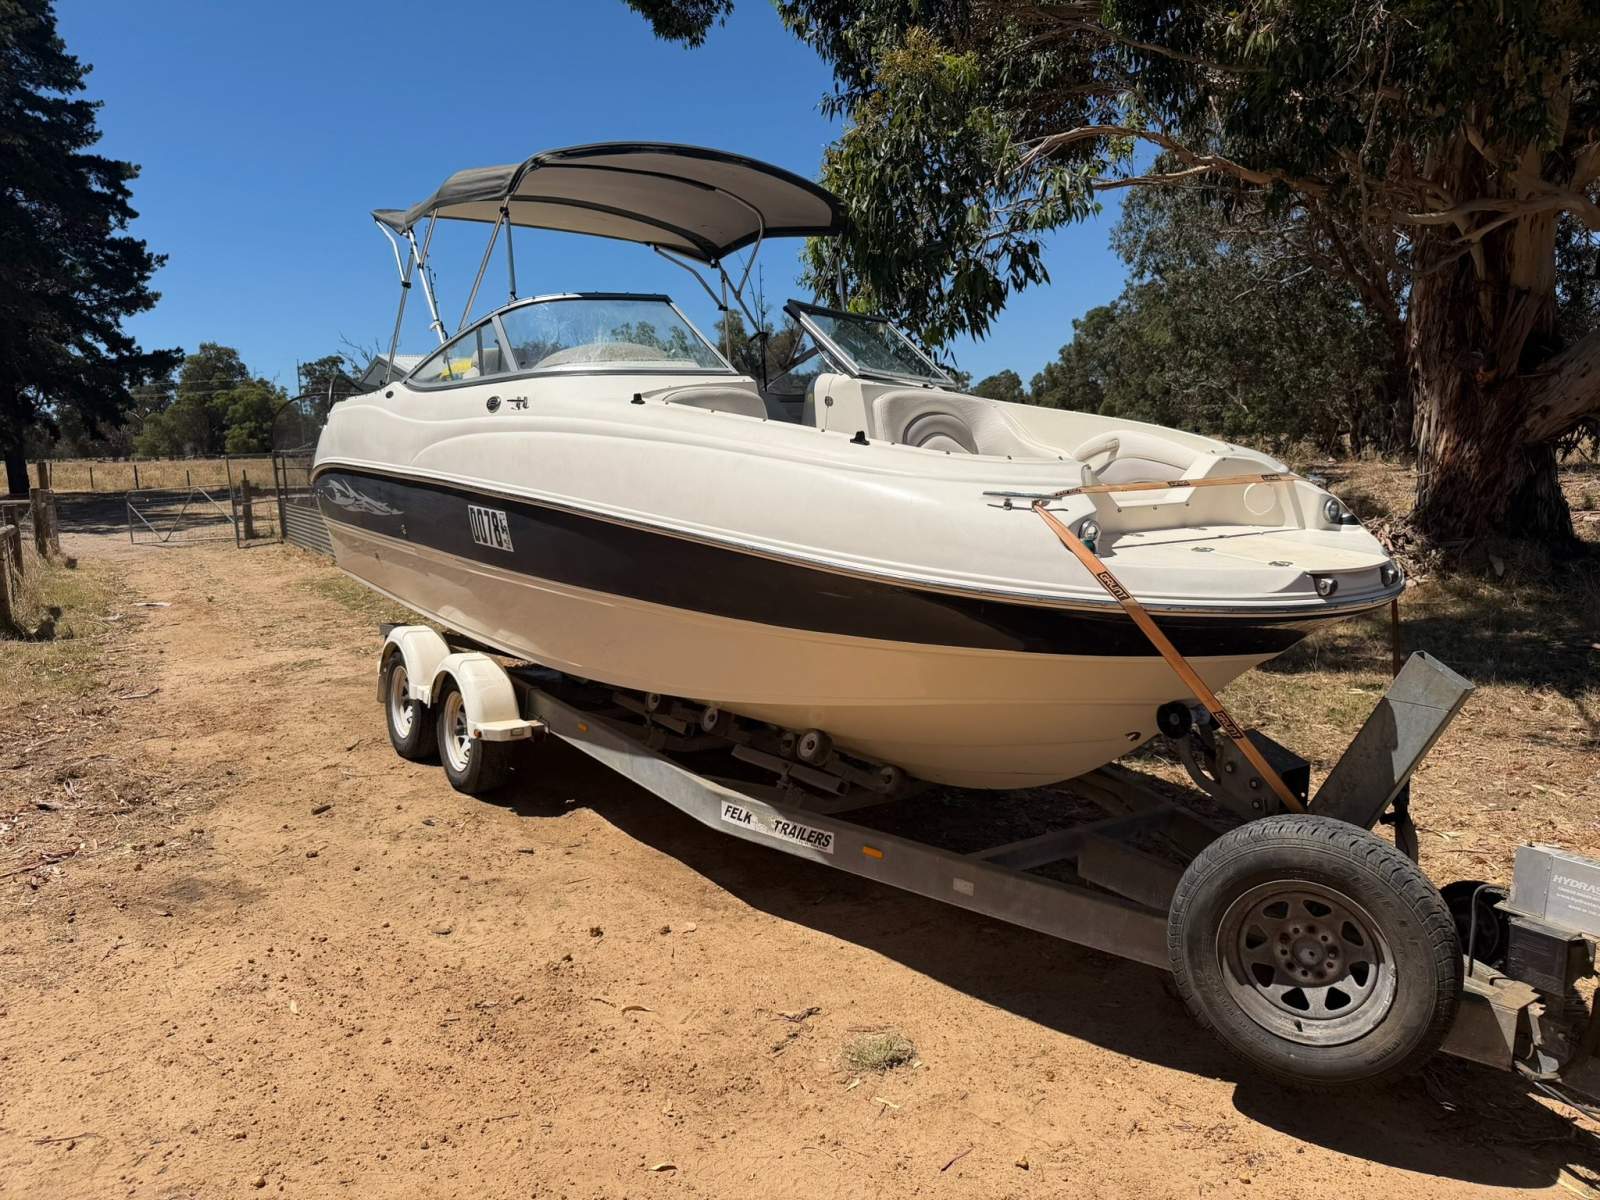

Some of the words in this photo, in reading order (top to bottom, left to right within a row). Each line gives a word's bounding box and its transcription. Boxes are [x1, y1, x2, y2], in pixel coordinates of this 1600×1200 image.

[1099, 572, 1129, 601] GRUNT
[1215, 711, 1243, 739] GRUNT
[724, 805, 752, 824] FELK
[774, 819, 832, 847] TRAILERS
